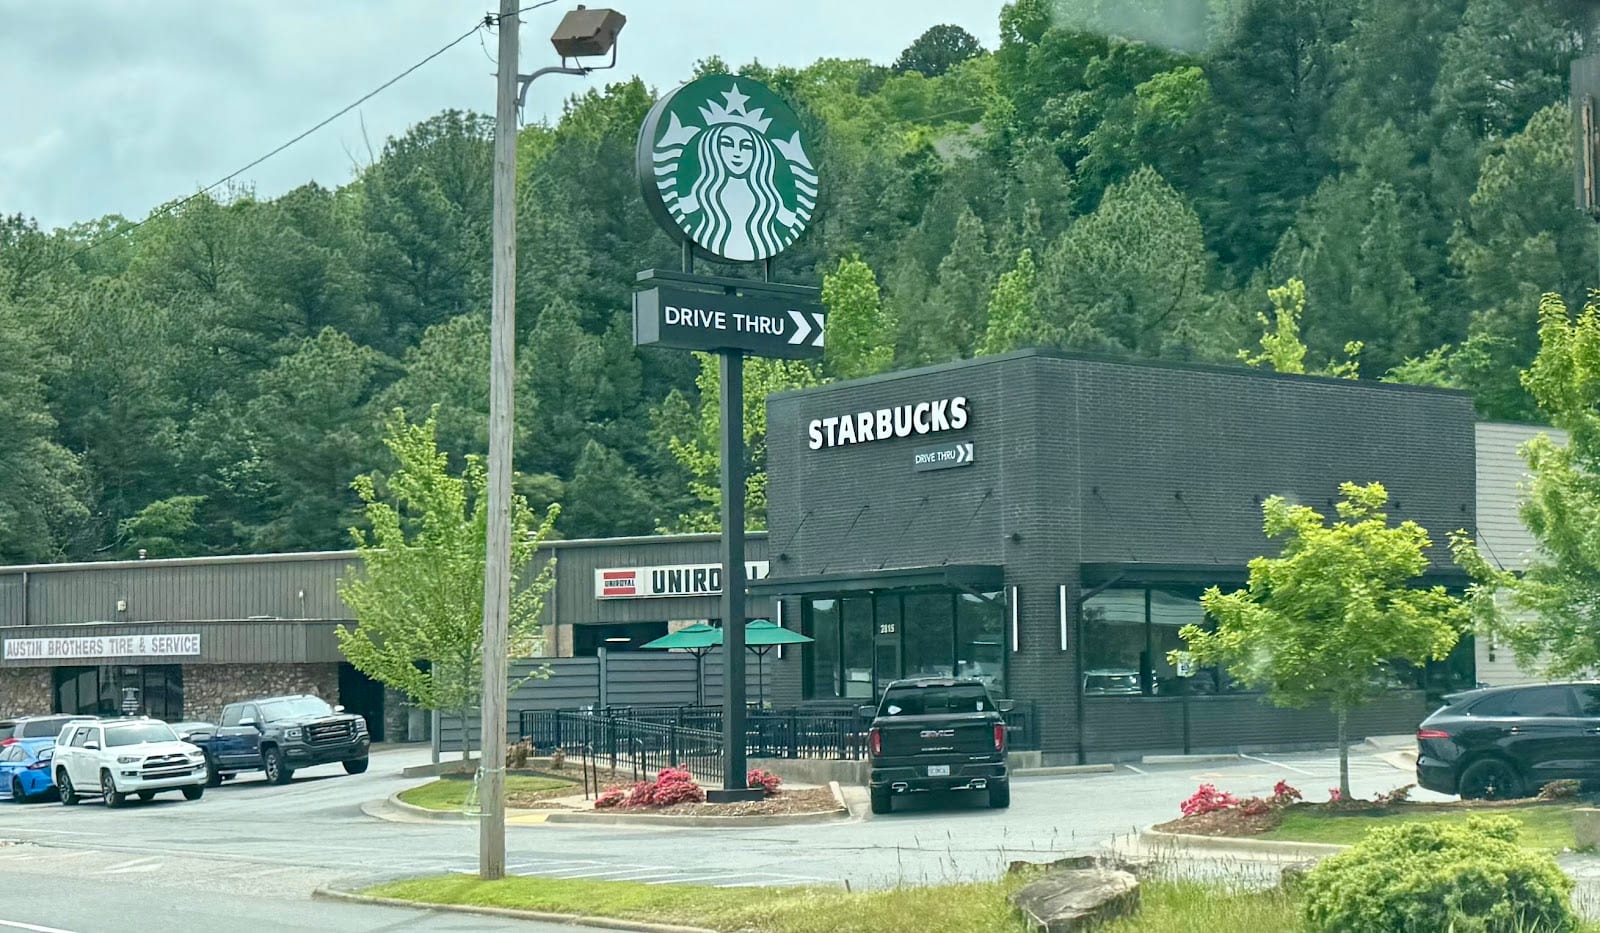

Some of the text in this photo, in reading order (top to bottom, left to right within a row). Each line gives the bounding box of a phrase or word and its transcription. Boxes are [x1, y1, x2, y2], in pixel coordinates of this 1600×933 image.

[665, 306, 785, 336] DRIVE THRU
[808, 396, 968, 450] STARBUCKS
[915, 449, 956, 465] DRIVE THRU
[6, 635, 198, 657] AUSTIN BROTHERS TIRE & SERVICE
